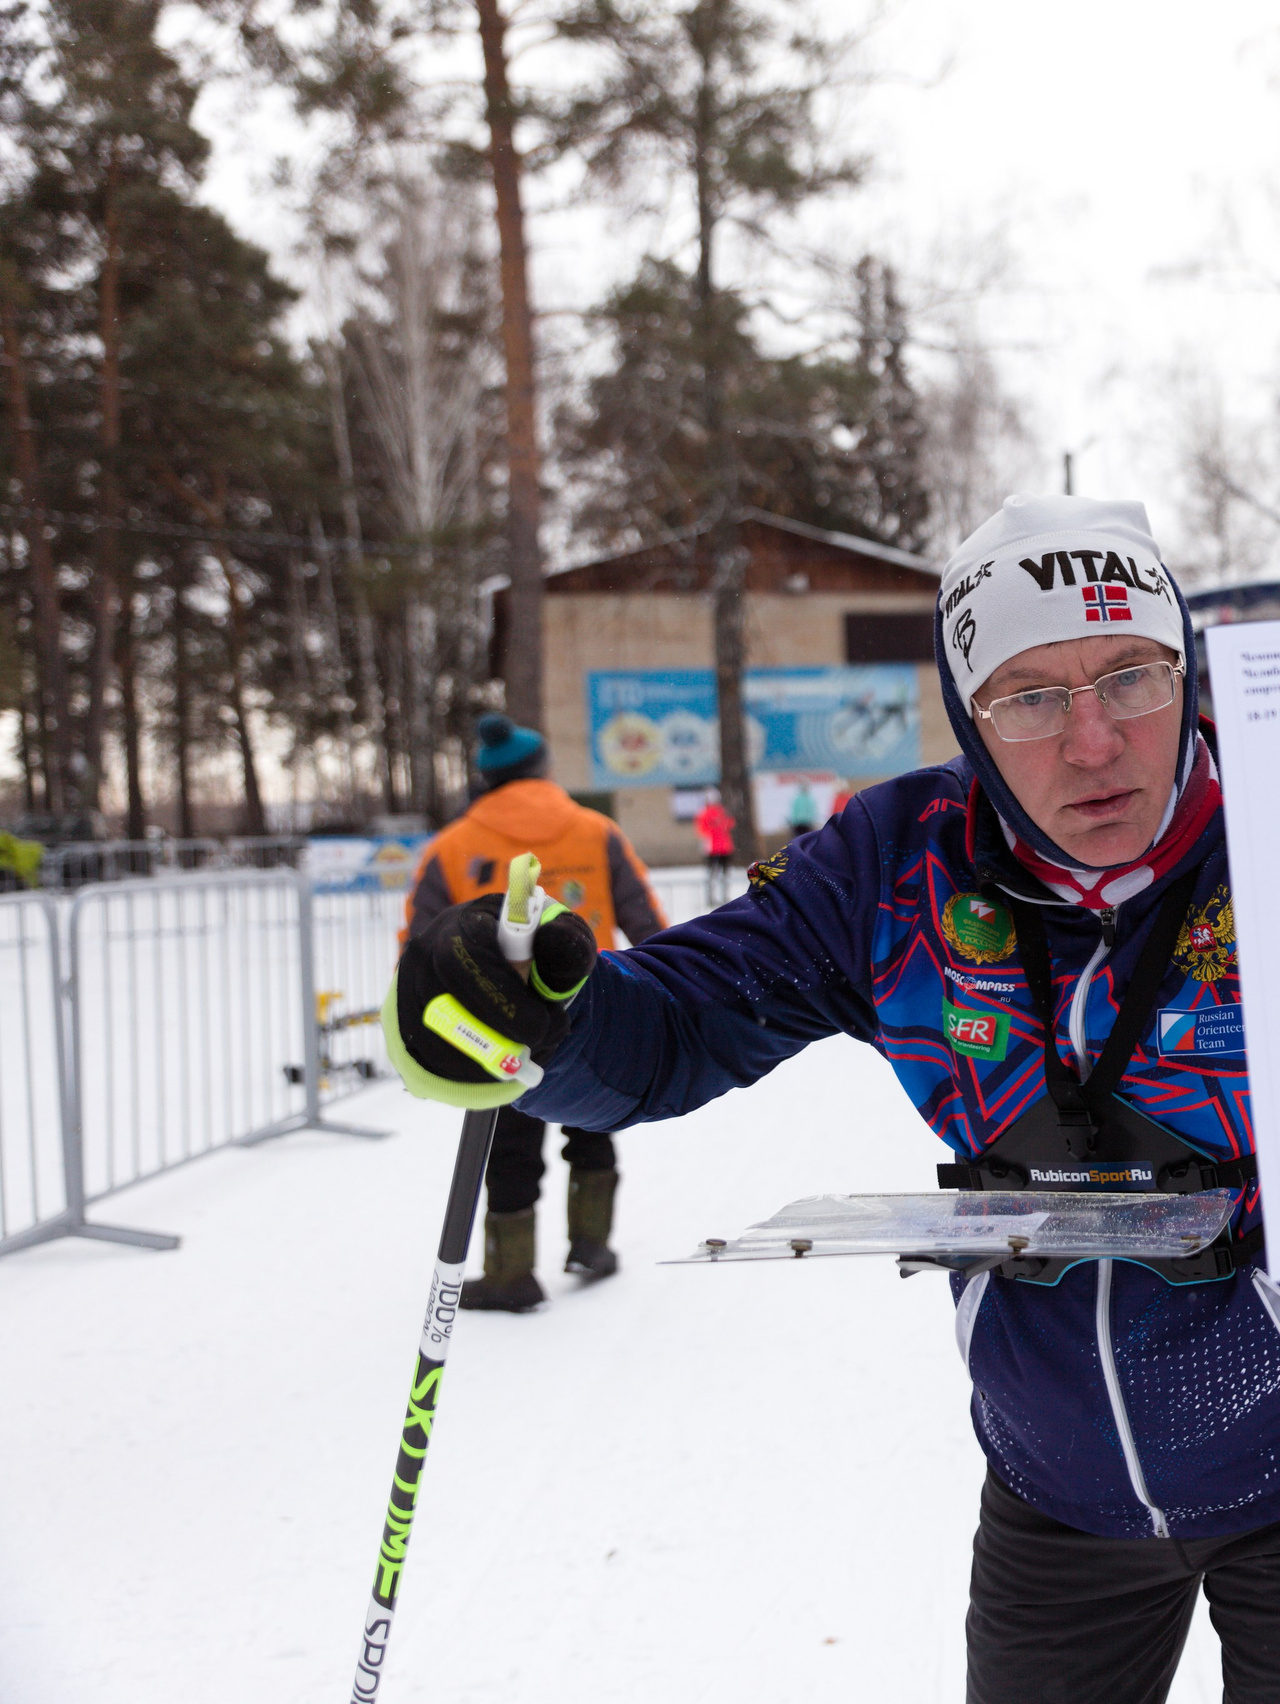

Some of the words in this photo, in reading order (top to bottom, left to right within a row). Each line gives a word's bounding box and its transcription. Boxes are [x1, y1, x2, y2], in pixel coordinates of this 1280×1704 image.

[1018, 549, 1154, 594] VITAL
[948, 1013, 989, 1042] SFR
[1198, 1010, 1235, 1024] Russian
[1197, 1039, 1226, 1050] Team
[1030, 1168, 1153, 1184] RubiconSportRu
[432, 1280, 461, 1344] 100%
